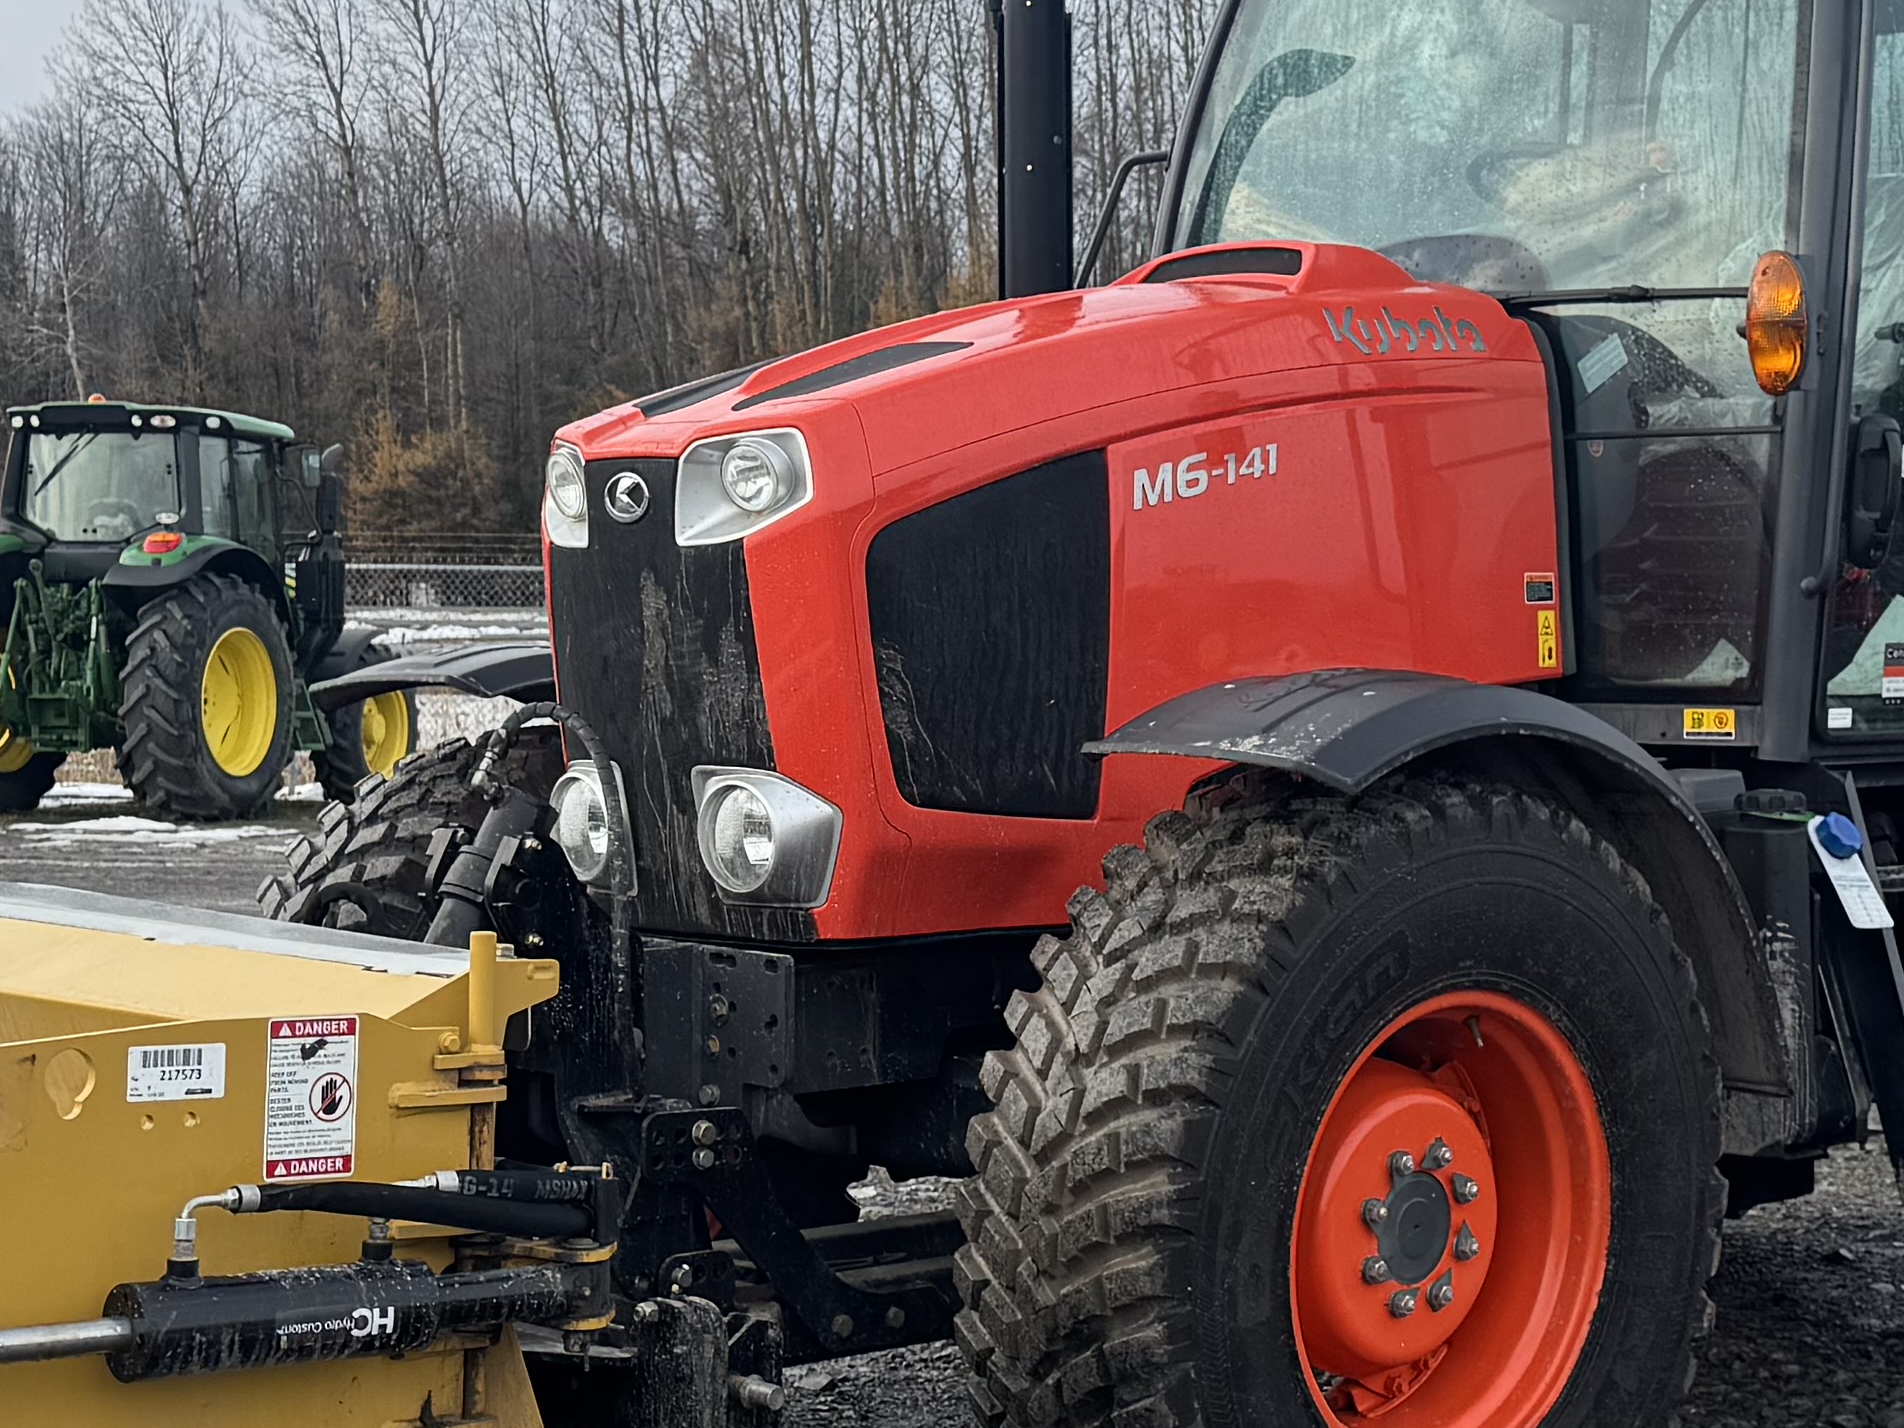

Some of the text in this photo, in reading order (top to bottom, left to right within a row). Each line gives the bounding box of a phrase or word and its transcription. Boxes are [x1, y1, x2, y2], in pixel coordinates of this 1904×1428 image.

[1322, 305, 1487, 355] Kubota
[1133, 443, 1278, 510] M6-141
[295, 1020, 348, 1036] DANGER
[159, 1069, 202, 1081] 217573
[290, 1157, 344, 1174] DANGER
[350, 1306, 396, 1338] HC
